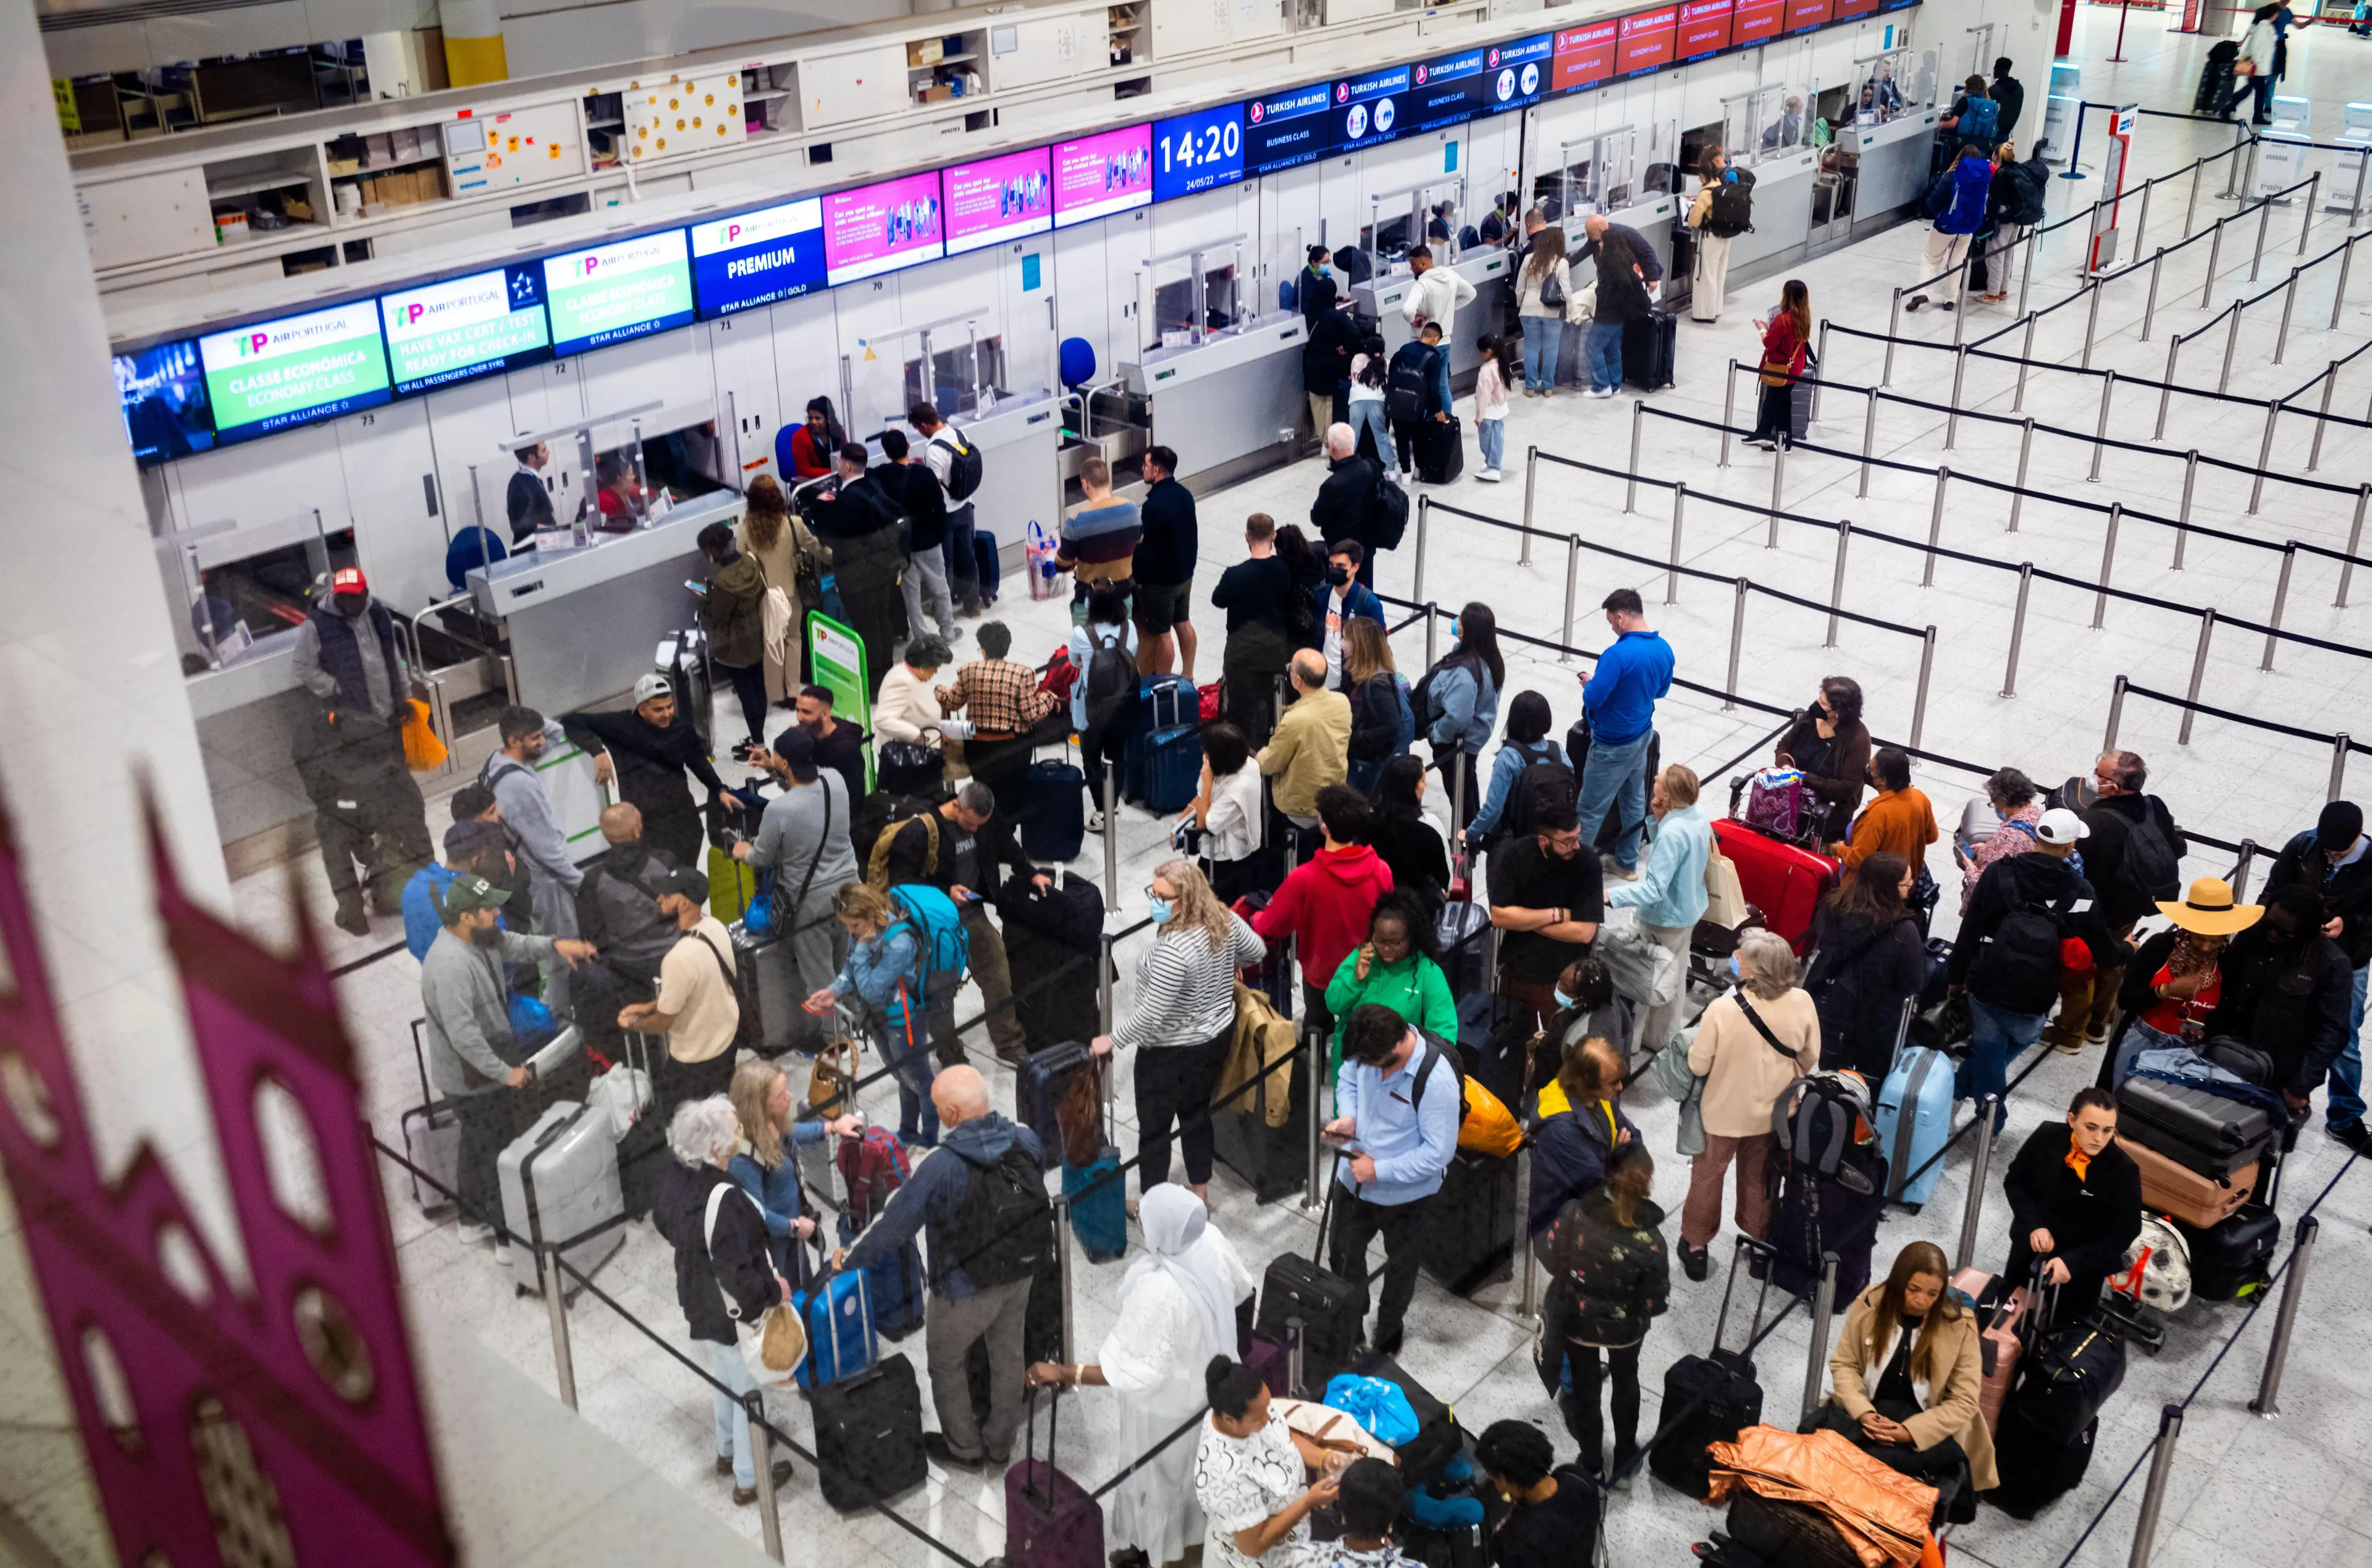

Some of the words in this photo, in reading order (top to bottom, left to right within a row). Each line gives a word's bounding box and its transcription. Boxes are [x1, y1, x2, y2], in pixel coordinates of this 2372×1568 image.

[1691, 5, 1710, 15] TURKISH
[1633, 19, 1653, 30] TURKISH
[1654, 12, 1674, 26] AIRLINES
[1569, 33, 1591, 44] TURKISH
[1592, 27, 1614, 38] AIRLINES
[1501, 47, 1525, 61] TURKISH
[1526, 41, 1549, 54] AIRLINES
[1429, 63, 1454, 77] TURKISH
[1455, 57, 1479, 71] AIRLINES
[1567, 62, 1588, 73] ECONOMY
[1351, 80, 1377, 95] TURKISH
[1379, 74, 1406, 86] AIRLINES
[1266, 99, 1295, 115] TURKISH
[1297, 92, 1326, 107] AIRLINES
[1428, 94, 1450, 107] BUSINESS
[1450, 91, 1465, 101] CLASS
[1505, 101, 1523, 111] ALLIANCE
[1160, 121, 1239, 173] 14:20
[1266, 133, 1292, 148] BUSINESS
[1293, 130, 1310, 138] CLASS
[1355, 137, 1377, 148] ALLIANCE
[1384, 133, 1396, 141] GOLD
[1072, 156, 1080, 165] you
[1259, 164, 1271, 173] STAR
[1272, 158, 1296, 170] ALLIANCE
[1303, 153, 1317, 161] GOLD
[1344, 159, 1351, 167] 66
[954, 183, 963, 191] Can
[964, 180, 972, 190] you
[1186, 175, 1214, 191] 24/05/22
[1244, 184, 1251, 193] 67
[835, 210, 844, 219] Can
[845, 208, 854, 217] you
[1135, 212, 1143, 221] 68
[718, 225, 741, 245] TP
[1014, 245, 1022, 253] 69
[571, 256, 599, 278] TP
[728, 247, 794, 279] PREMIUM
[873, 282, 882, 290] 70
[566, 290, 608, 312] CLASSE
[579, 300, 634, 325] ECONOMY
[635, 293, 666, 310] CLASS
[721, 301, 739, 314] STAR
[741, 291, 776, 308] ALLIANCE
[788, 284, 807, 296] GOLD
[400, 338, 434, 357] HAVE
[436, 330, 462, 345] VAX
[465, 322, 496, 340] CERT
[507, 312, 535, 328] TEST
[590, 333, 610, 345] STAR
[613, 322, 652, 338] ALLIANCE
[720, 320, 731, 331] 71
[233, 333, 268, 358] TAP
[405, 352, 446, 373] READY
[450, 343, 476, 358] FOR
[478, 330, 536, 354] CHECK-IN
[229, 367, 282, 394] CLASSE
[411, 378, 424, 390] ALL
[425, 366, 468, 387] PASSENGERS
[469, 362, 487, 375] OVER
[247, 379, 314, 408] ECONOMY
[316, 370, 355, 390] CLASS
[262, 416, 288, 430] STAR
[290, 404, 339, 422] ALLIANCE
[361, 414, 375, 426] 73
